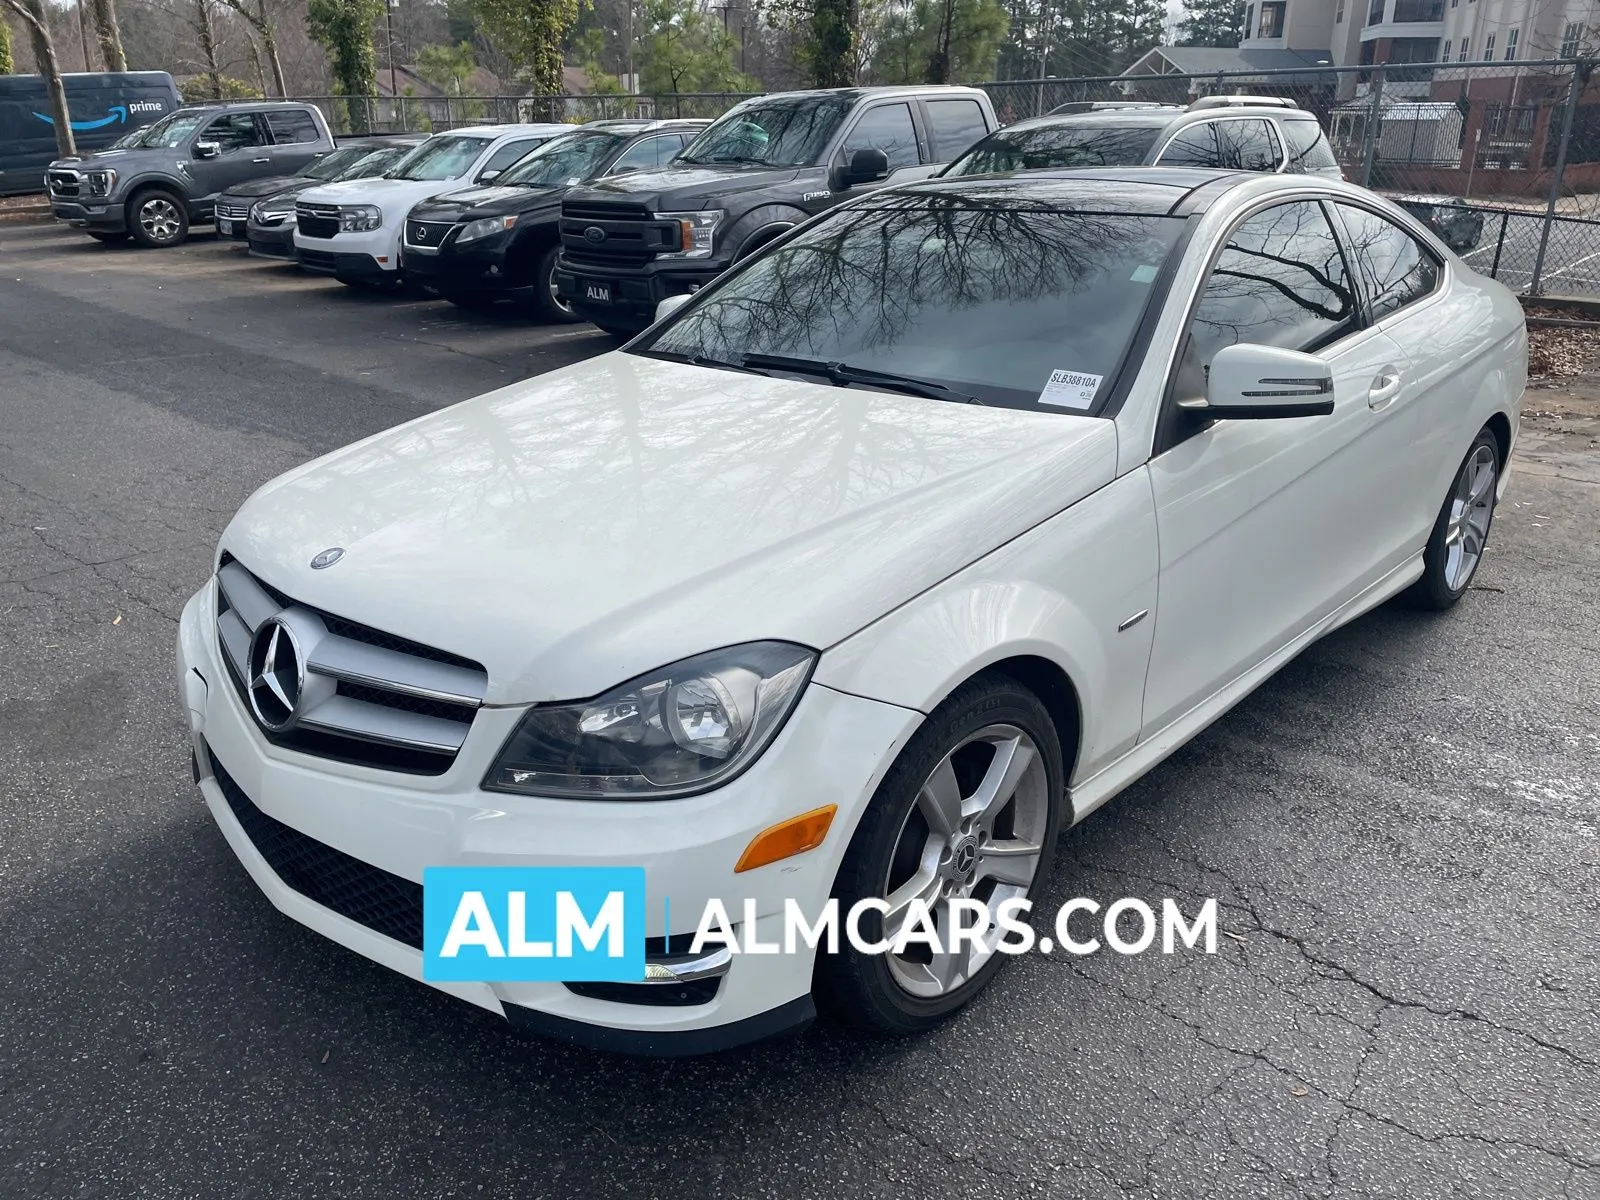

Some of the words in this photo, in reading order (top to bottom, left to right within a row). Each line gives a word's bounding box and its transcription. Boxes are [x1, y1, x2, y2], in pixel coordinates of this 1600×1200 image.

[129, 101, 162, 114] prime
[587, 286, 609, 301] ALM
[1050, 373, 1097, 388] SLB38810A
